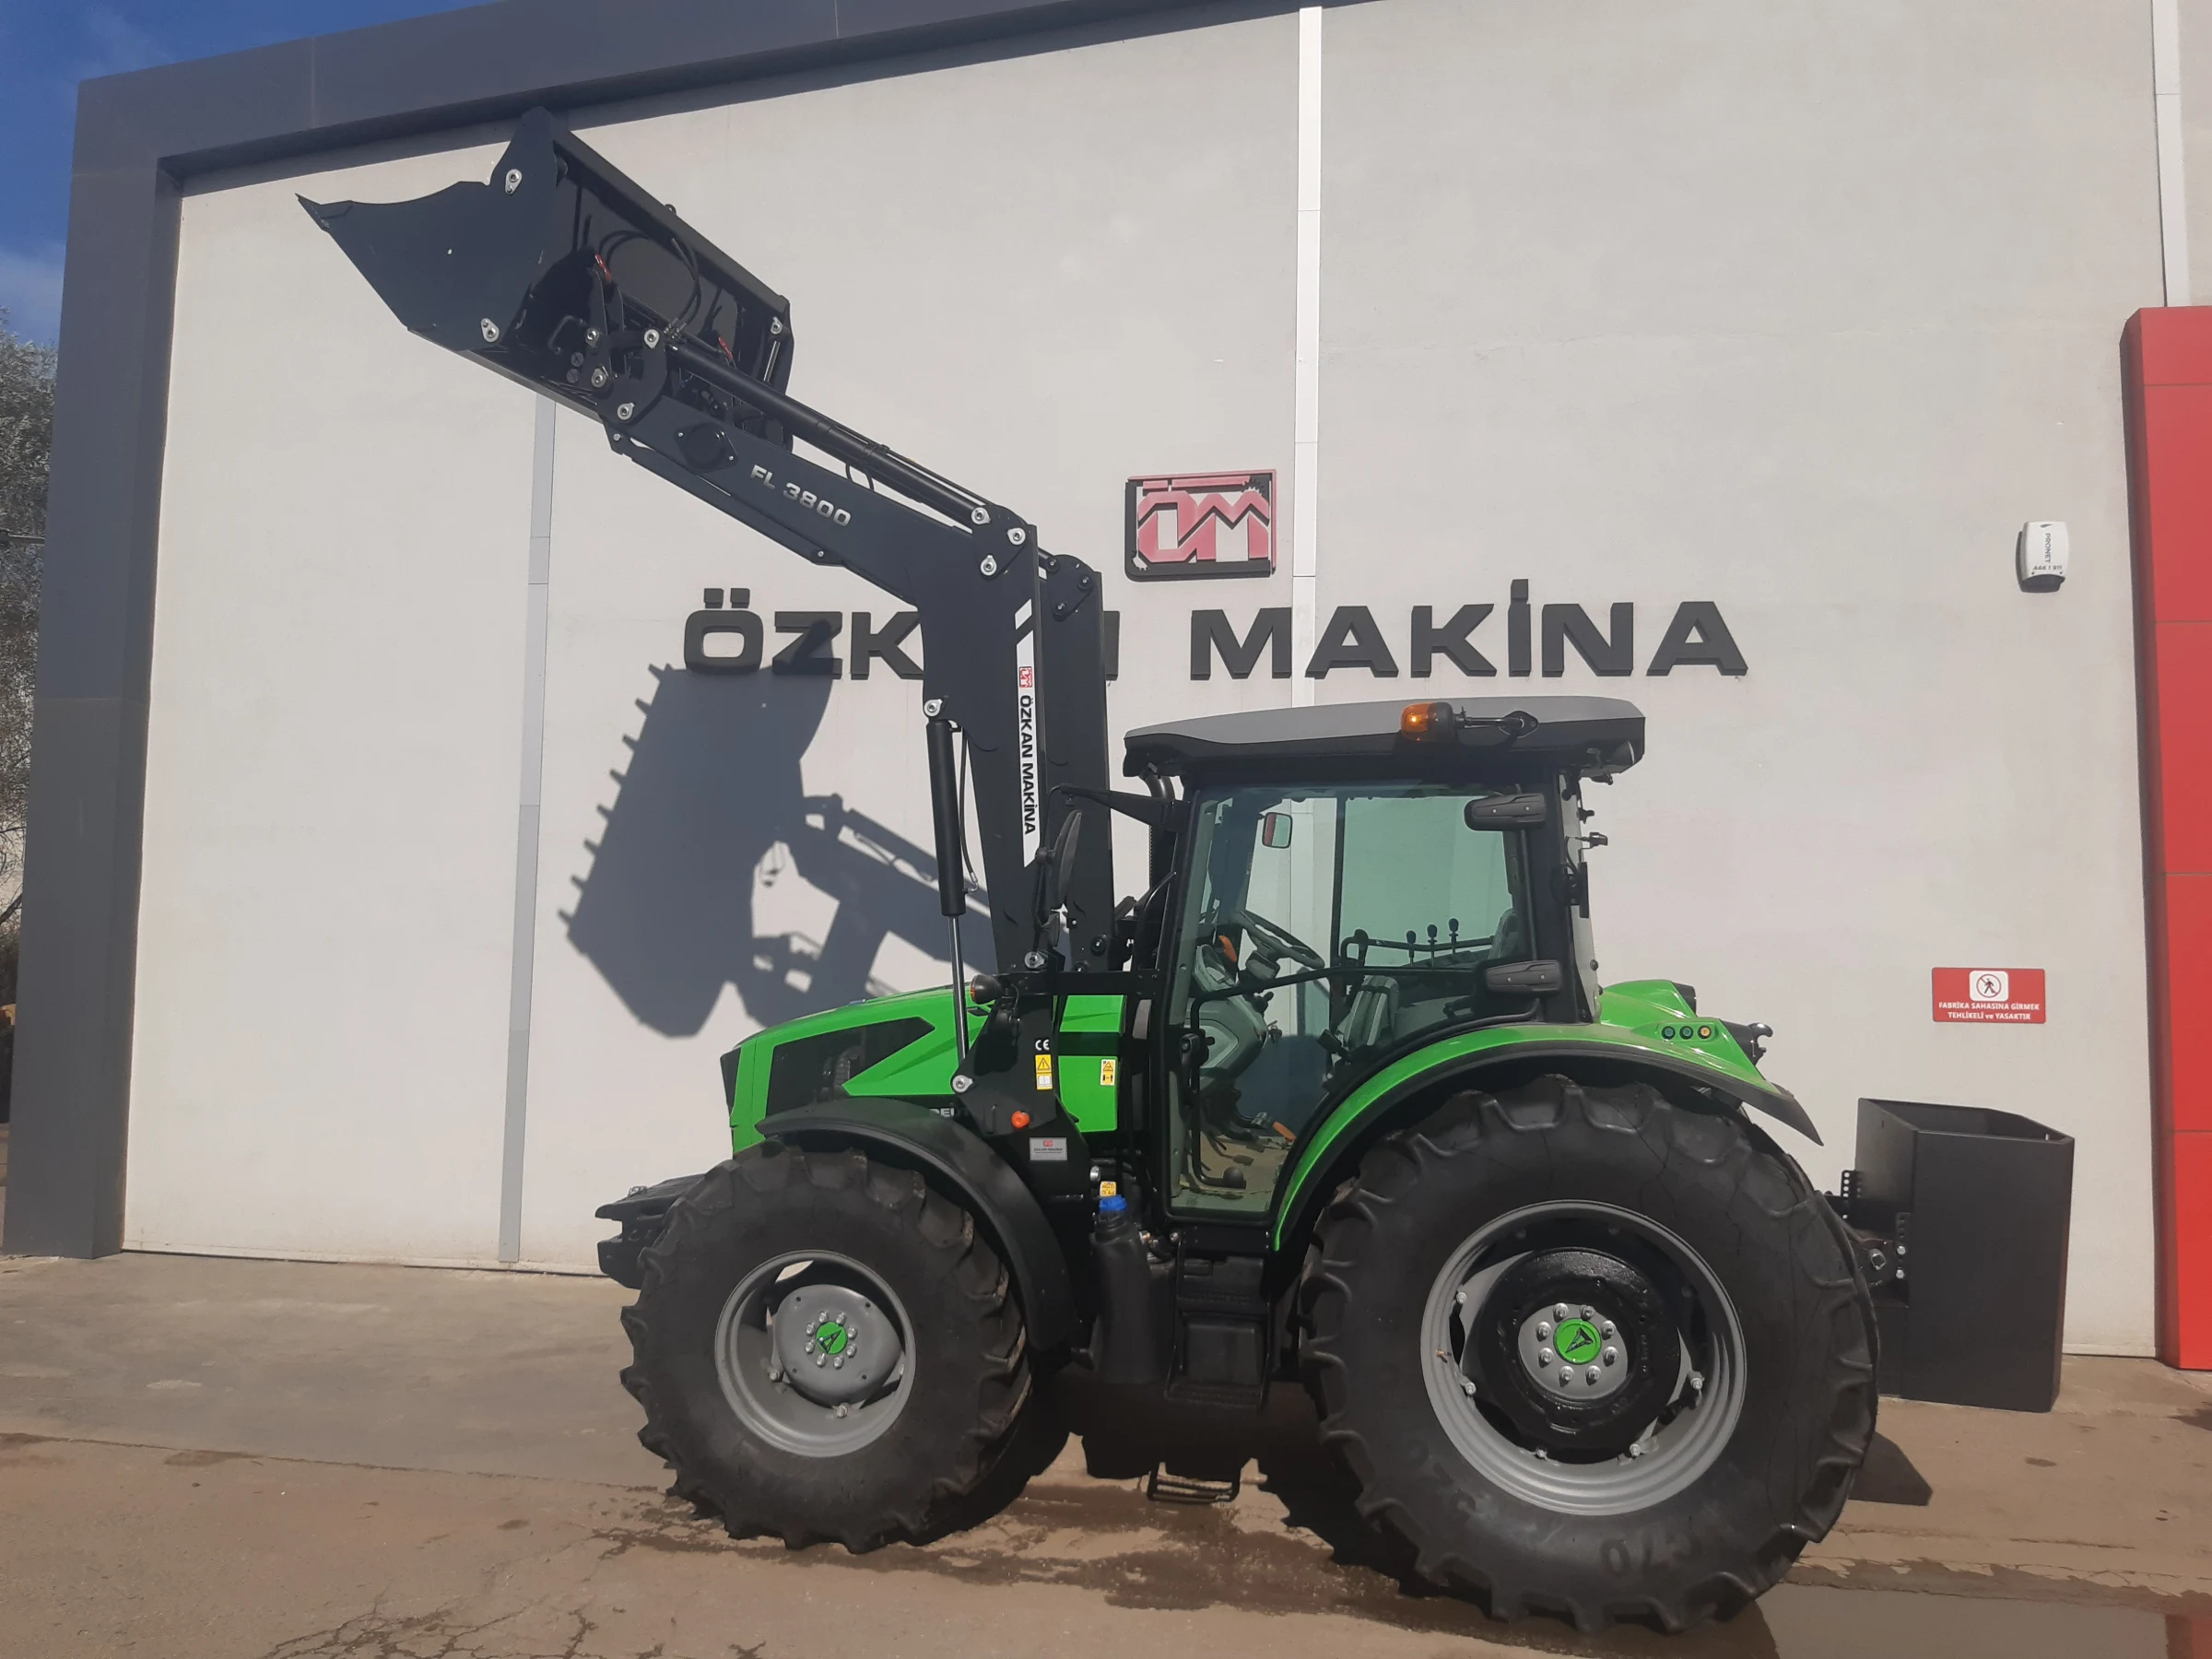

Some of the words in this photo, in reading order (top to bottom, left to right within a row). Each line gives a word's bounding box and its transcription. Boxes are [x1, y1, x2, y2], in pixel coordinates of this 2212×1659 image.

[750, 465, 775, 489] FL
[783, 482, 852, 526] 3800
[684, 587, 1120, 680] ÖZK
[1191, 579, 1748, 681] MAKİNA
[1020, 695, 1033, 758] ÖZKAN
[1022, 762, 1038, 835] MAKİNA
[1938, 1001, 1970, 1010] FABRİKA
[1947, 1011, 1984, 1019] TEHLİKELİ
[1035, 1039, 1050, 1051] CE
